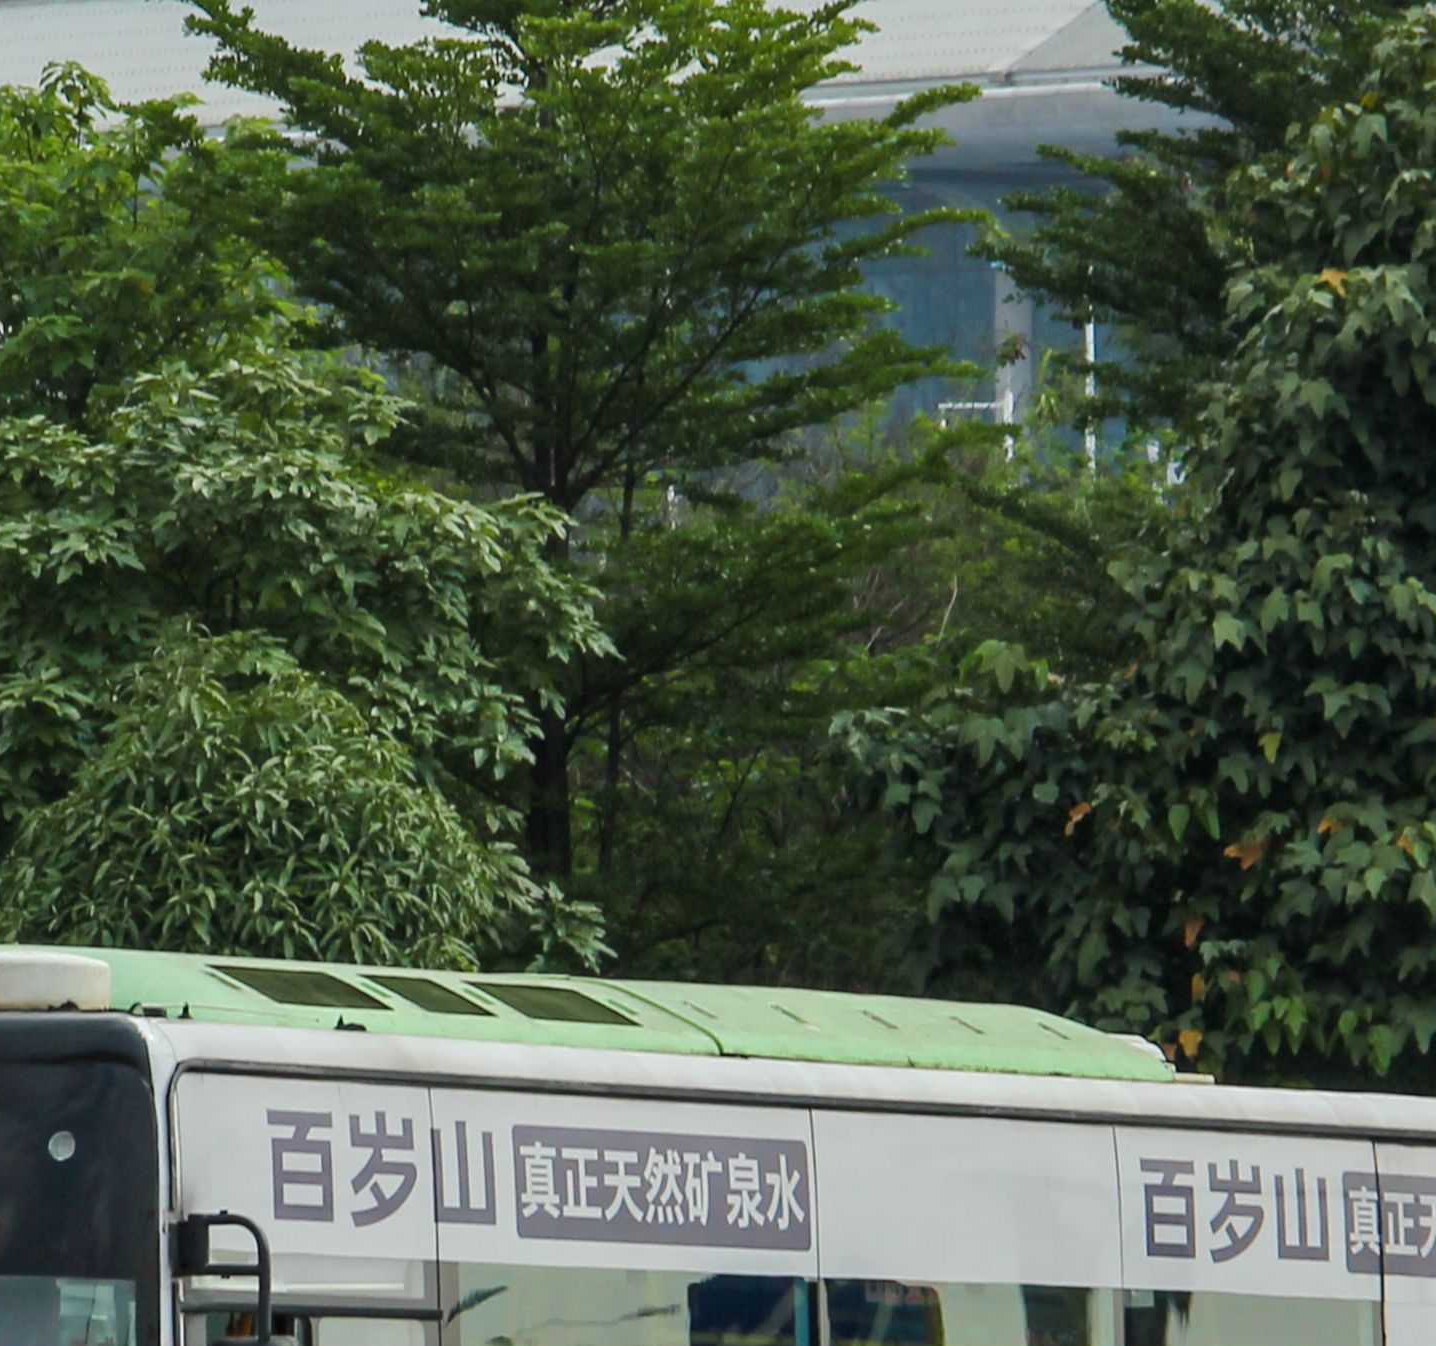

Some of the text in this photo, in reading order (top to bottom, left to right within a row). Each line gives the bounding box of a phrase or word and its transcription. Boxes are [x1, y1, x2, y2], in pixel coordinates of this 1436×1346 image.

[266, 1109, 807, 1231] 百岁山 真正天然矿泉水
[1139, 1157, 1330, 1263] 百岁山
